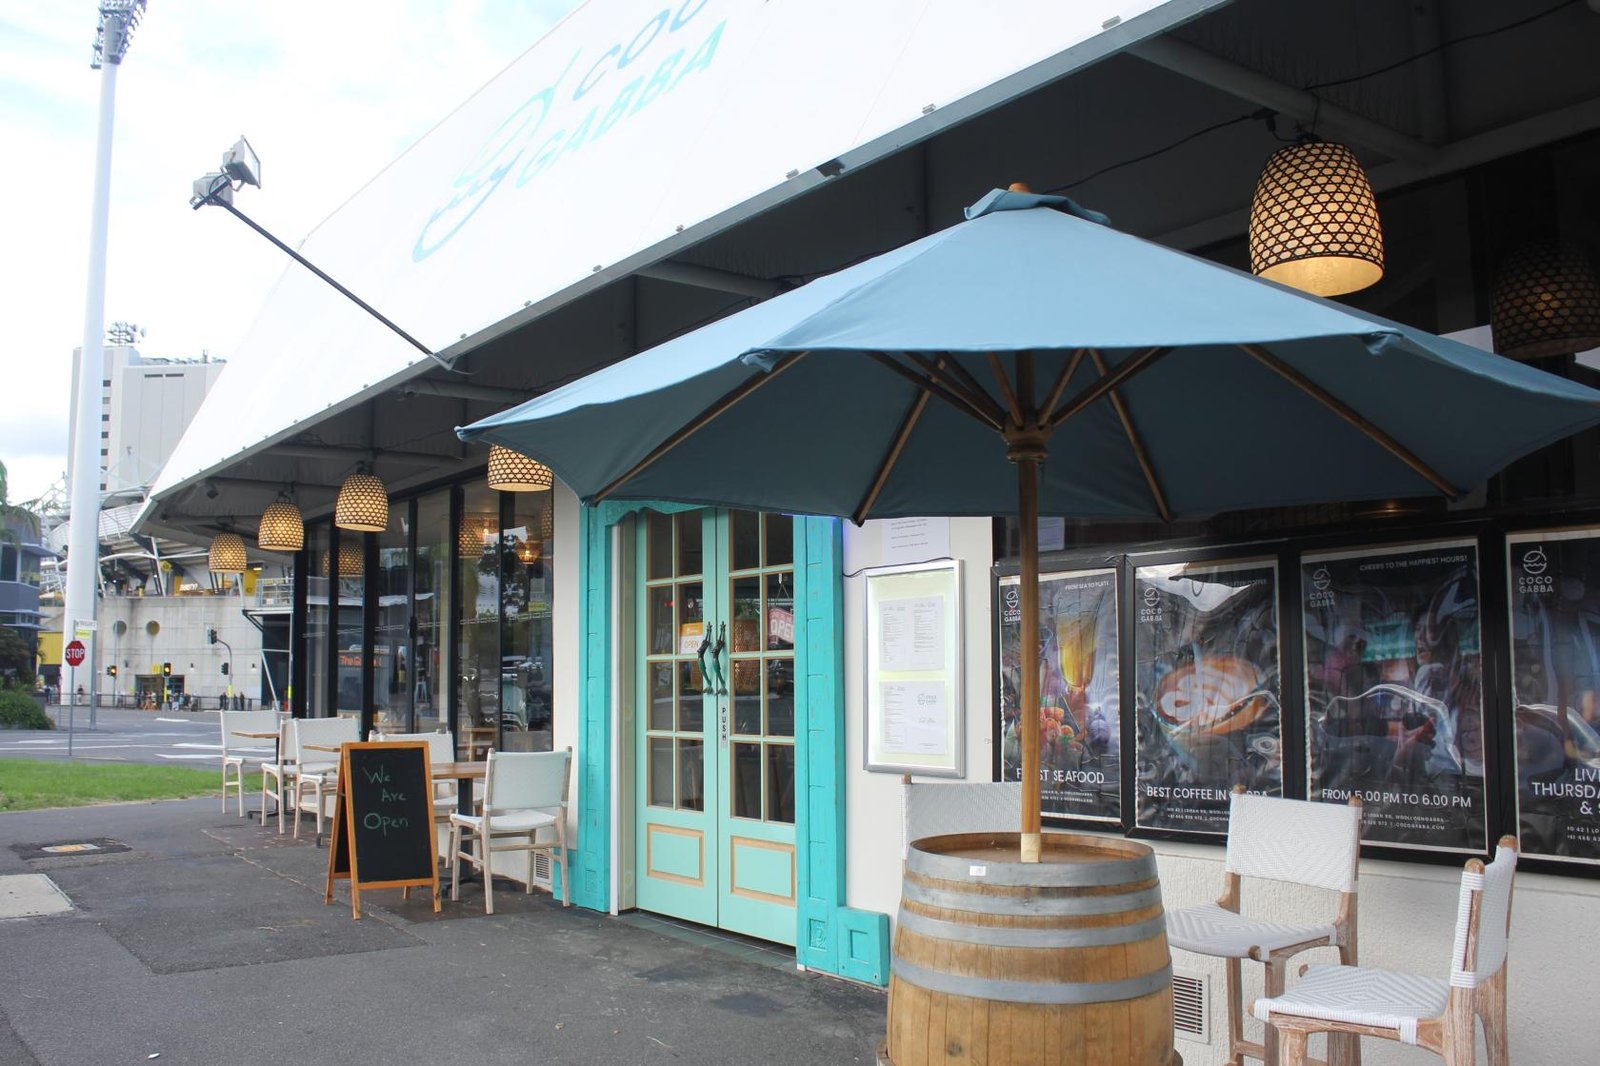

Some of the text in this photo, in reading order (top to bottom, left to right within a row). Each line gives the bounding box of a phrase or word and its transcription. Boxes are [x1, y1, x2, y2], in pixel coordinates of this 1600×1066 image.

[516, 18, 727, 189] GABBA
[1395, 560, 1408, 568] THE
[1440, 555, 1468, 564] HOURS!
[1519, 576, 1553, 585] COCO
[1309, 590, 1335, 600] COCO
[1519, 585, 1554, 594] GABBA
[66, 648, 85, 659] STOP
[362, 764, 392, 785] We
[1053, 769, 1105, 784] SEAFOOD
[1575, 768, 1600, 782] LIV
[381, 787, 408, 803] Are
[1147, 786, 1171, 798] BEST
[1173, 788, 1213, 800] COFFEE
[1215, 789, 1227, 801] IN
[1322, 788, 1351, 800] FROM
[1383, 792, 1400, 803] PM
[1402, 793, 1419, 805] TO
[1422, 794, 1449, 806] 6.00
[1452, 796, 1472, 808] PM
[1580, 801, 1593, 815] &
[363, 812, 409, 838] Open
